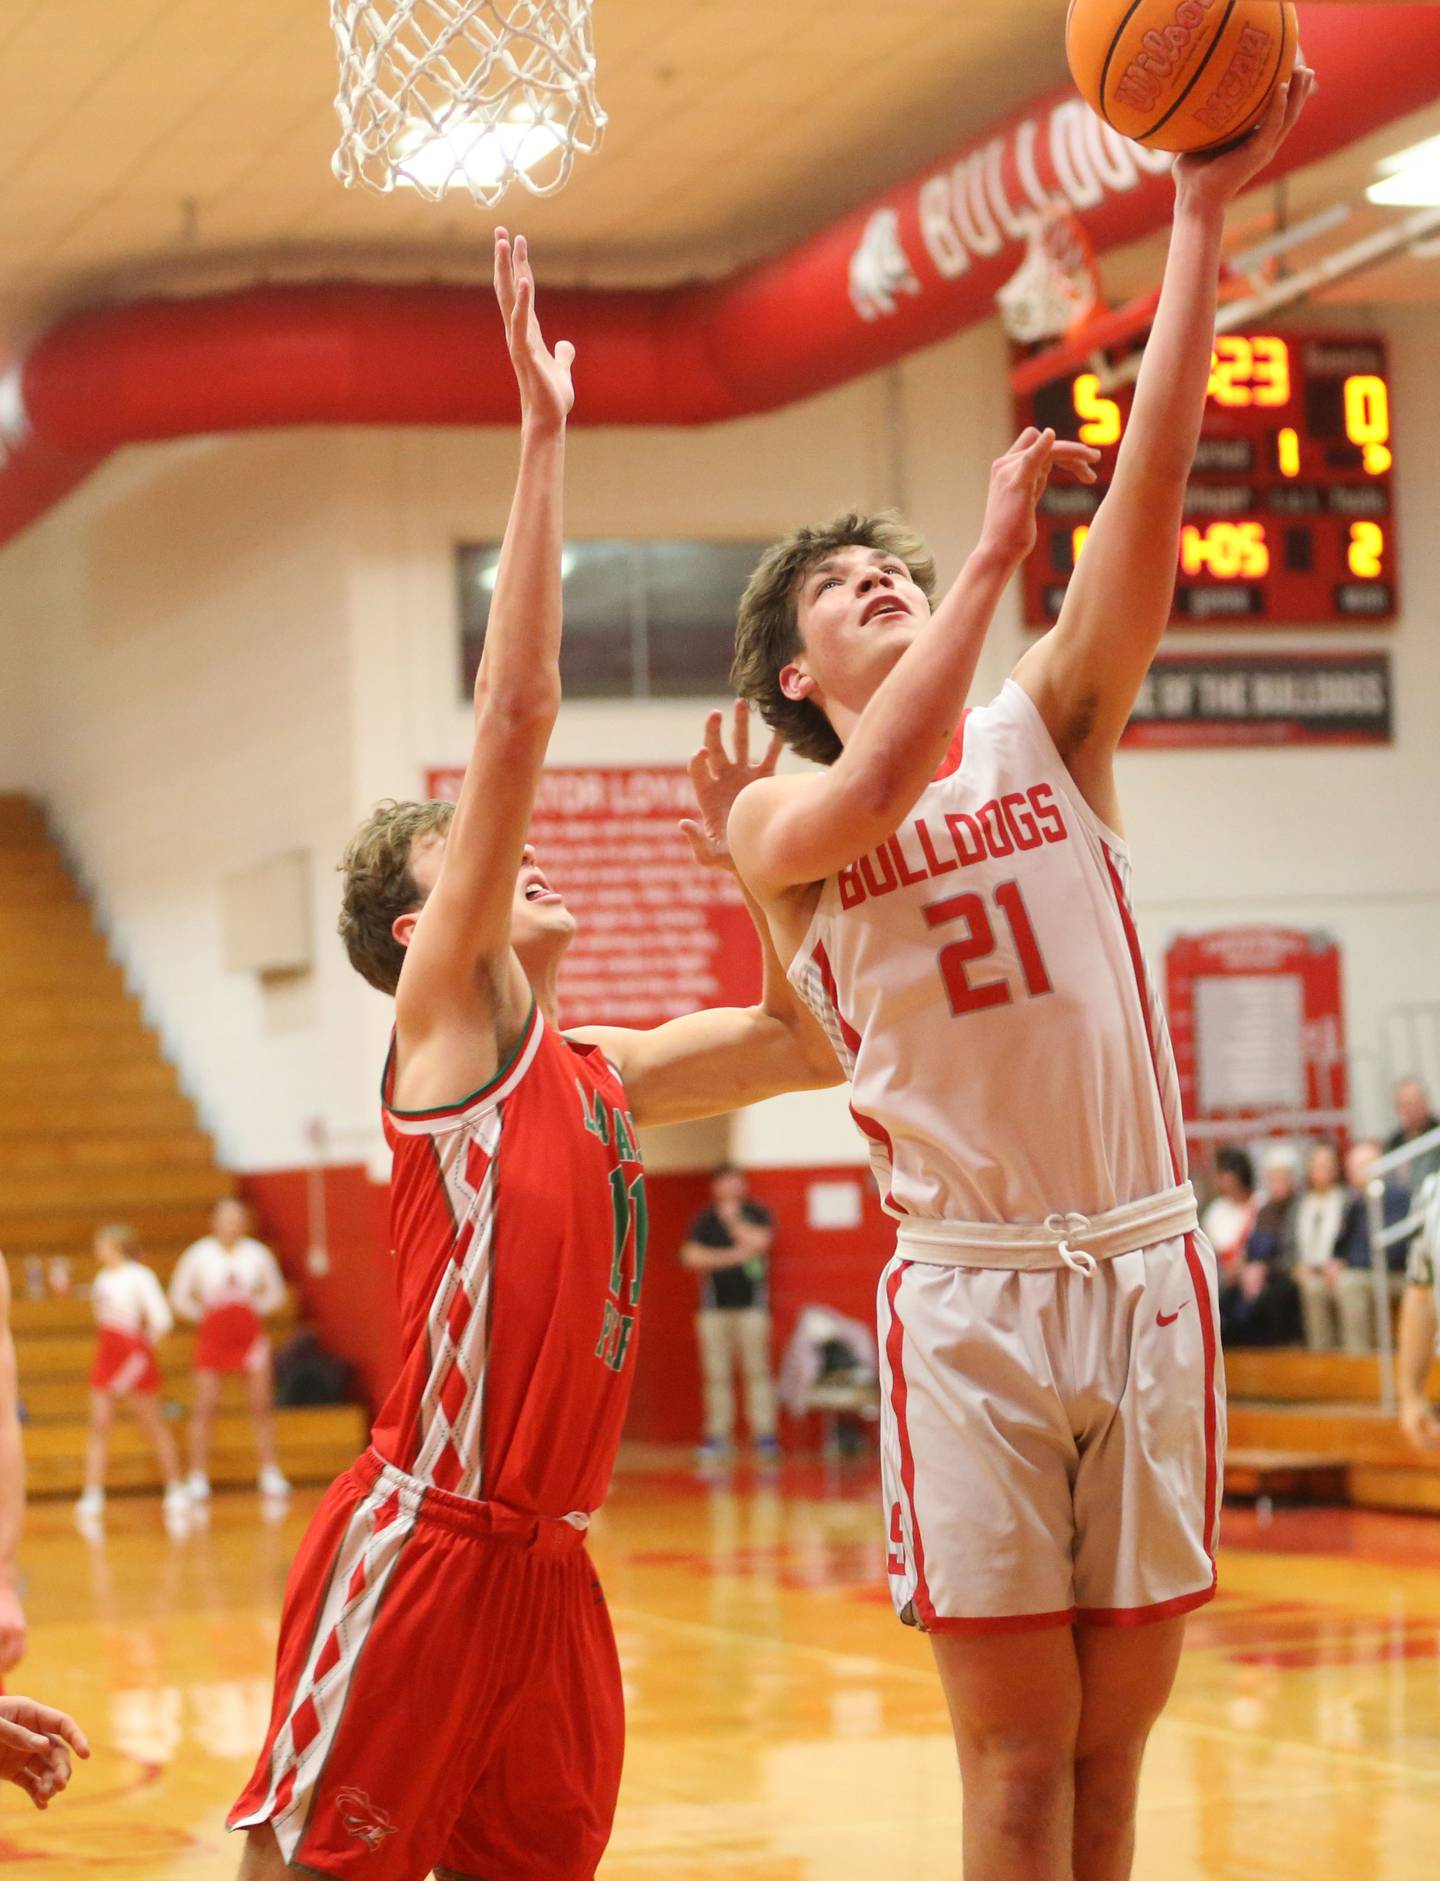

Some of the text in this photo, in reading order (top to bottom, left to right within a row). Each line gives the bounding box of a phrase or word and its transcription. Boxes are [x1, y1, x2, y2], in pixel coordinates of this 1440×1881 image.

[1277, 427, 1300, 478] 1
[1343, 374, 1390, 446] 0
[1347, 521, 1384, 578] 2
[837, 781, 1069, 912] BULLDOGS
[920, 877, 1055, 1019] 21
[607, 1164, 648, 1308] 11
